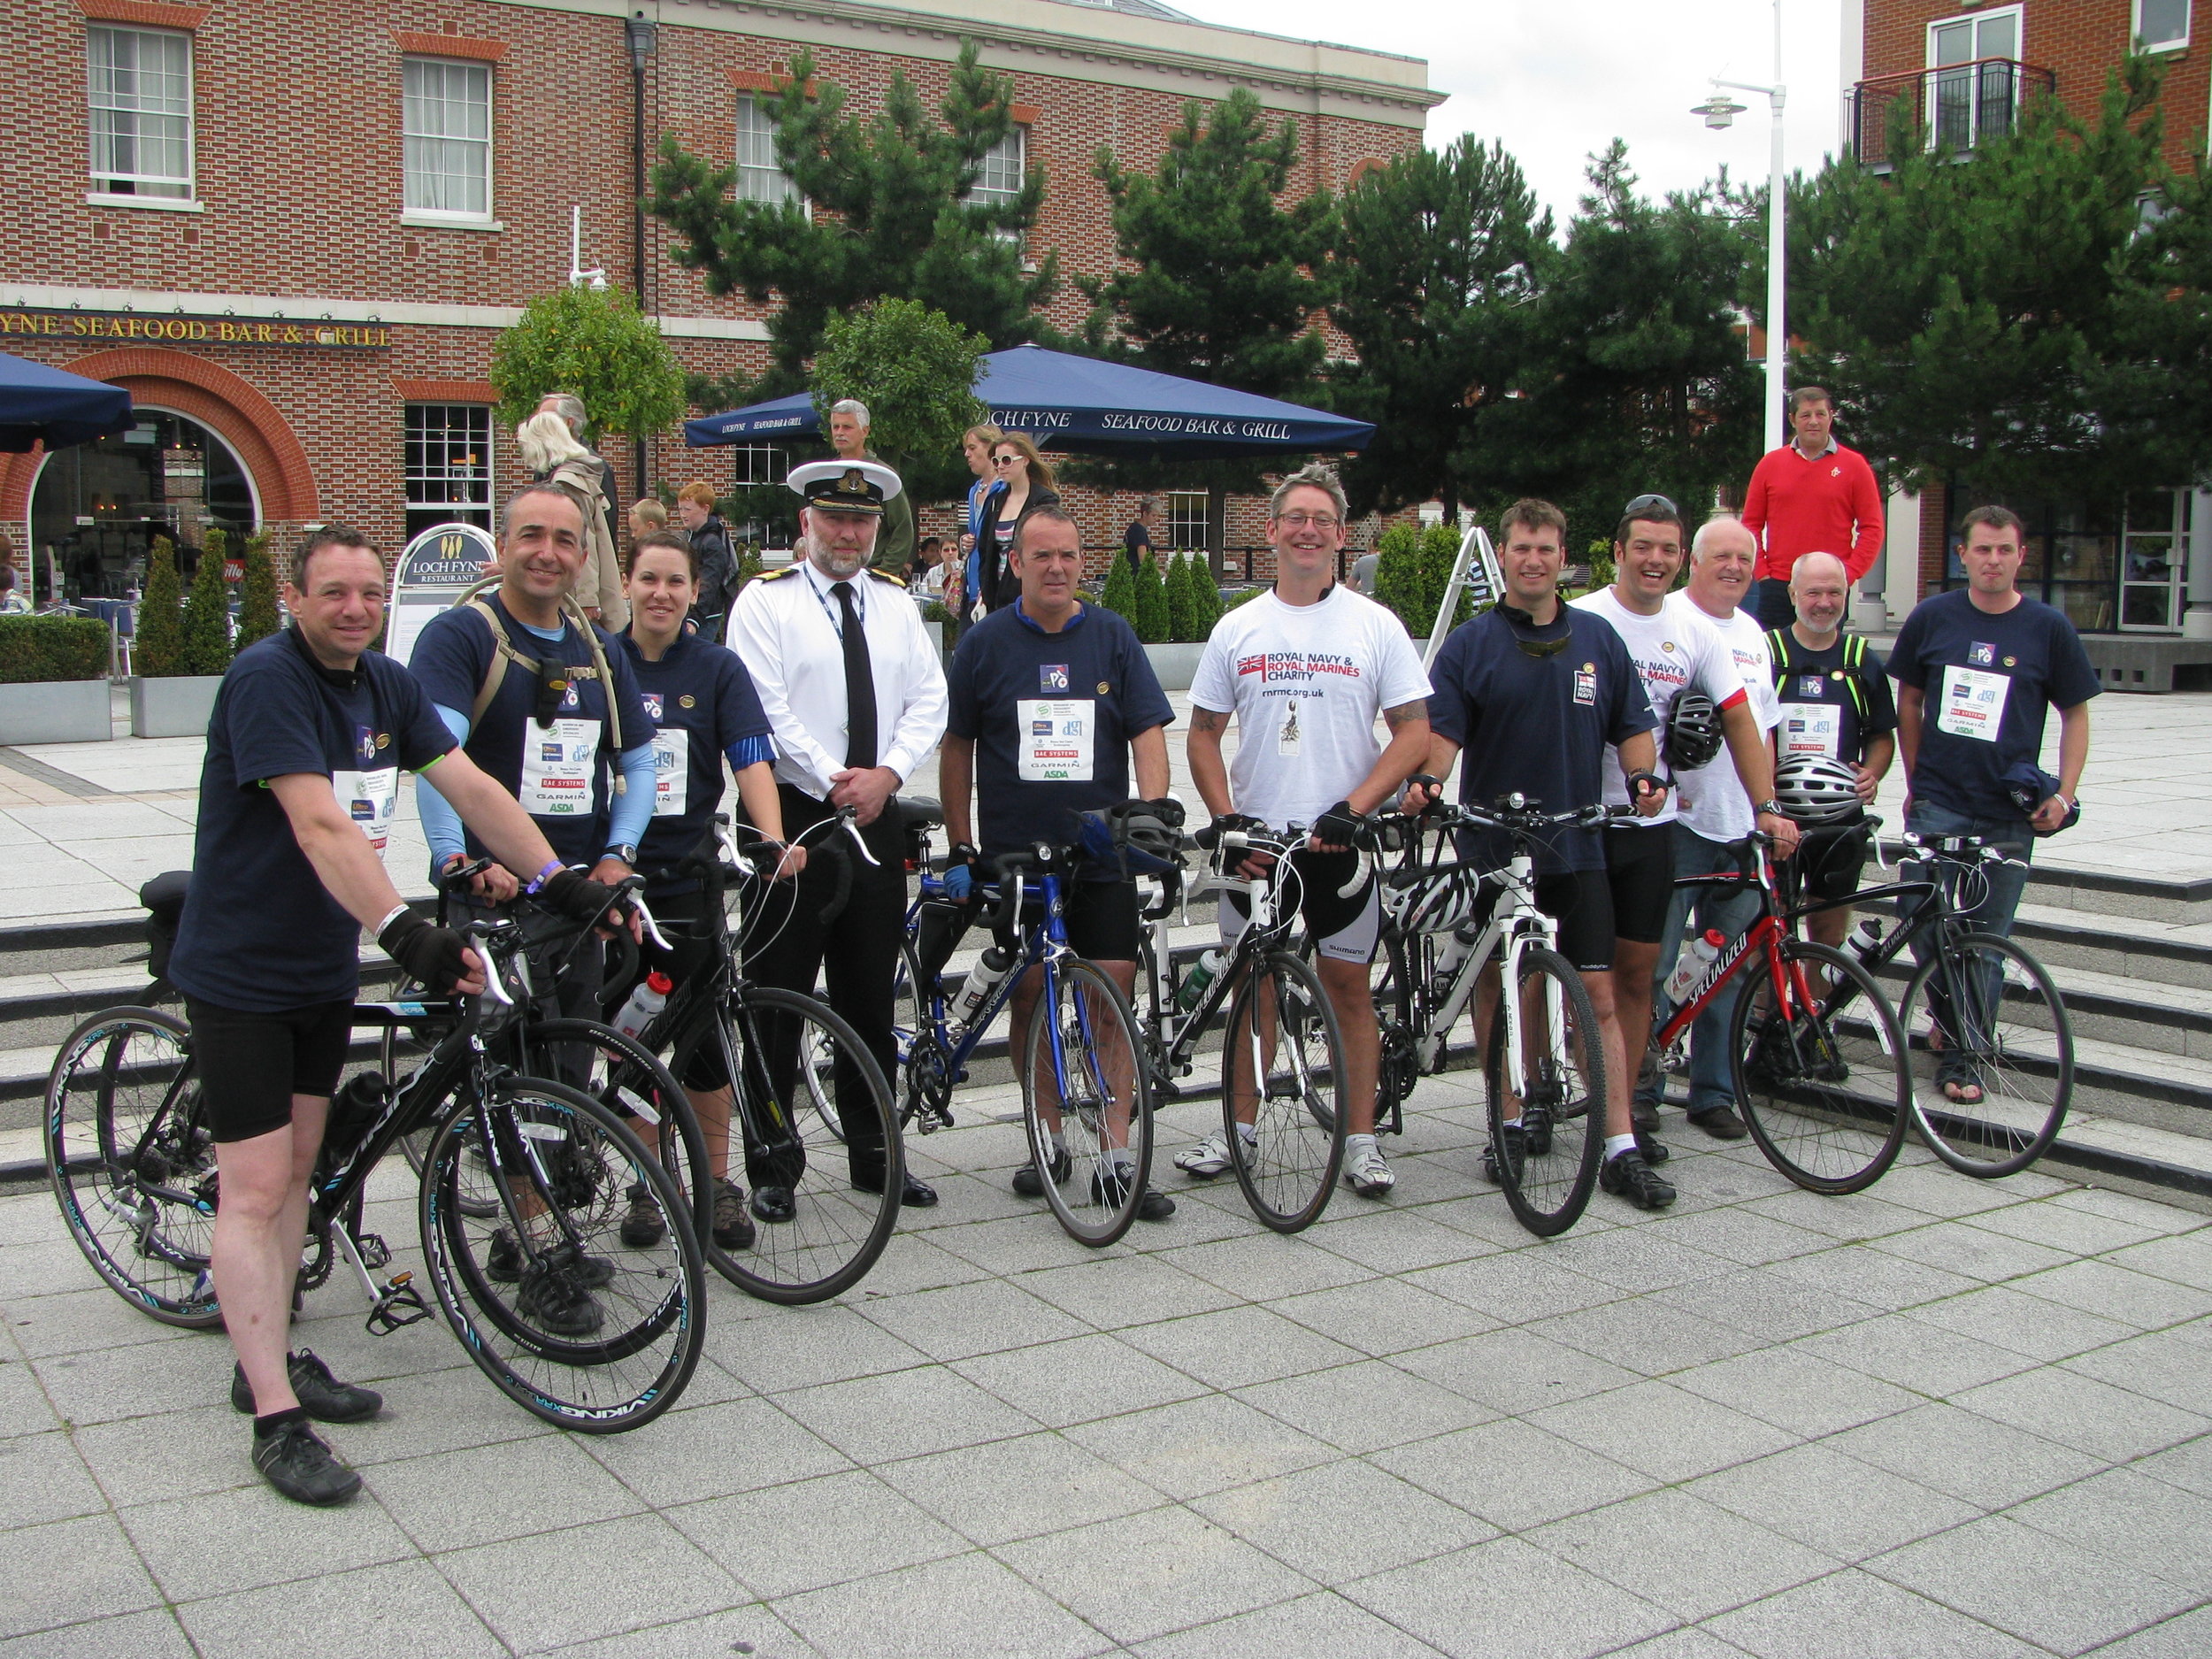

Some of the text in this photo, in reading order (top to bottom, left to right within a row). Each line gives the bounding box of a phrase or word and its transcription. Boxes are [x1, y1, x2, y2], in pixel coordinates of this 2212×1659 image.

[73, 317, 206, 340] SEAFOOD
[219, 322, 273, 342] BAR
[283, 325, 303, 343] &
[315, 326, 392, 346] GRILL
[1020, 411, 1071, 427] FYNE
[1102, 414, 1183, 432] SEAFOOD
[1185, 419, 1219, 434] BAR
[1223, 421, 1236, 435] &
[1241, 422, 1291, 440] GRILL
[413, 561, 449, 573] LOCH
[421, 574, 475, 583] RESTAURANT
[1268, 653, 1353, 666] ROYAL NAVY &
[1268, 663, 1360, 678] ROYAL MARINES
[1649, 662, 1678, 674] NAVY
[1268, 672, 1315, 681] CHARITY
[1262, 688, 1324, 698] rnrmc.org.uk
[1961, 710, 1985, 719] SYSTEMS
[1955, 726, 1974, 735] ASDA
[1044, 770, 1069, 779] ASDA
[549, 803, 574, 812] ASDA
[1329, 944, 1365, 956] SHIMANO
[1689, 932, 1747, 1010] SPECIALIZED
[560, 1399, 648, 1419] VIKING
